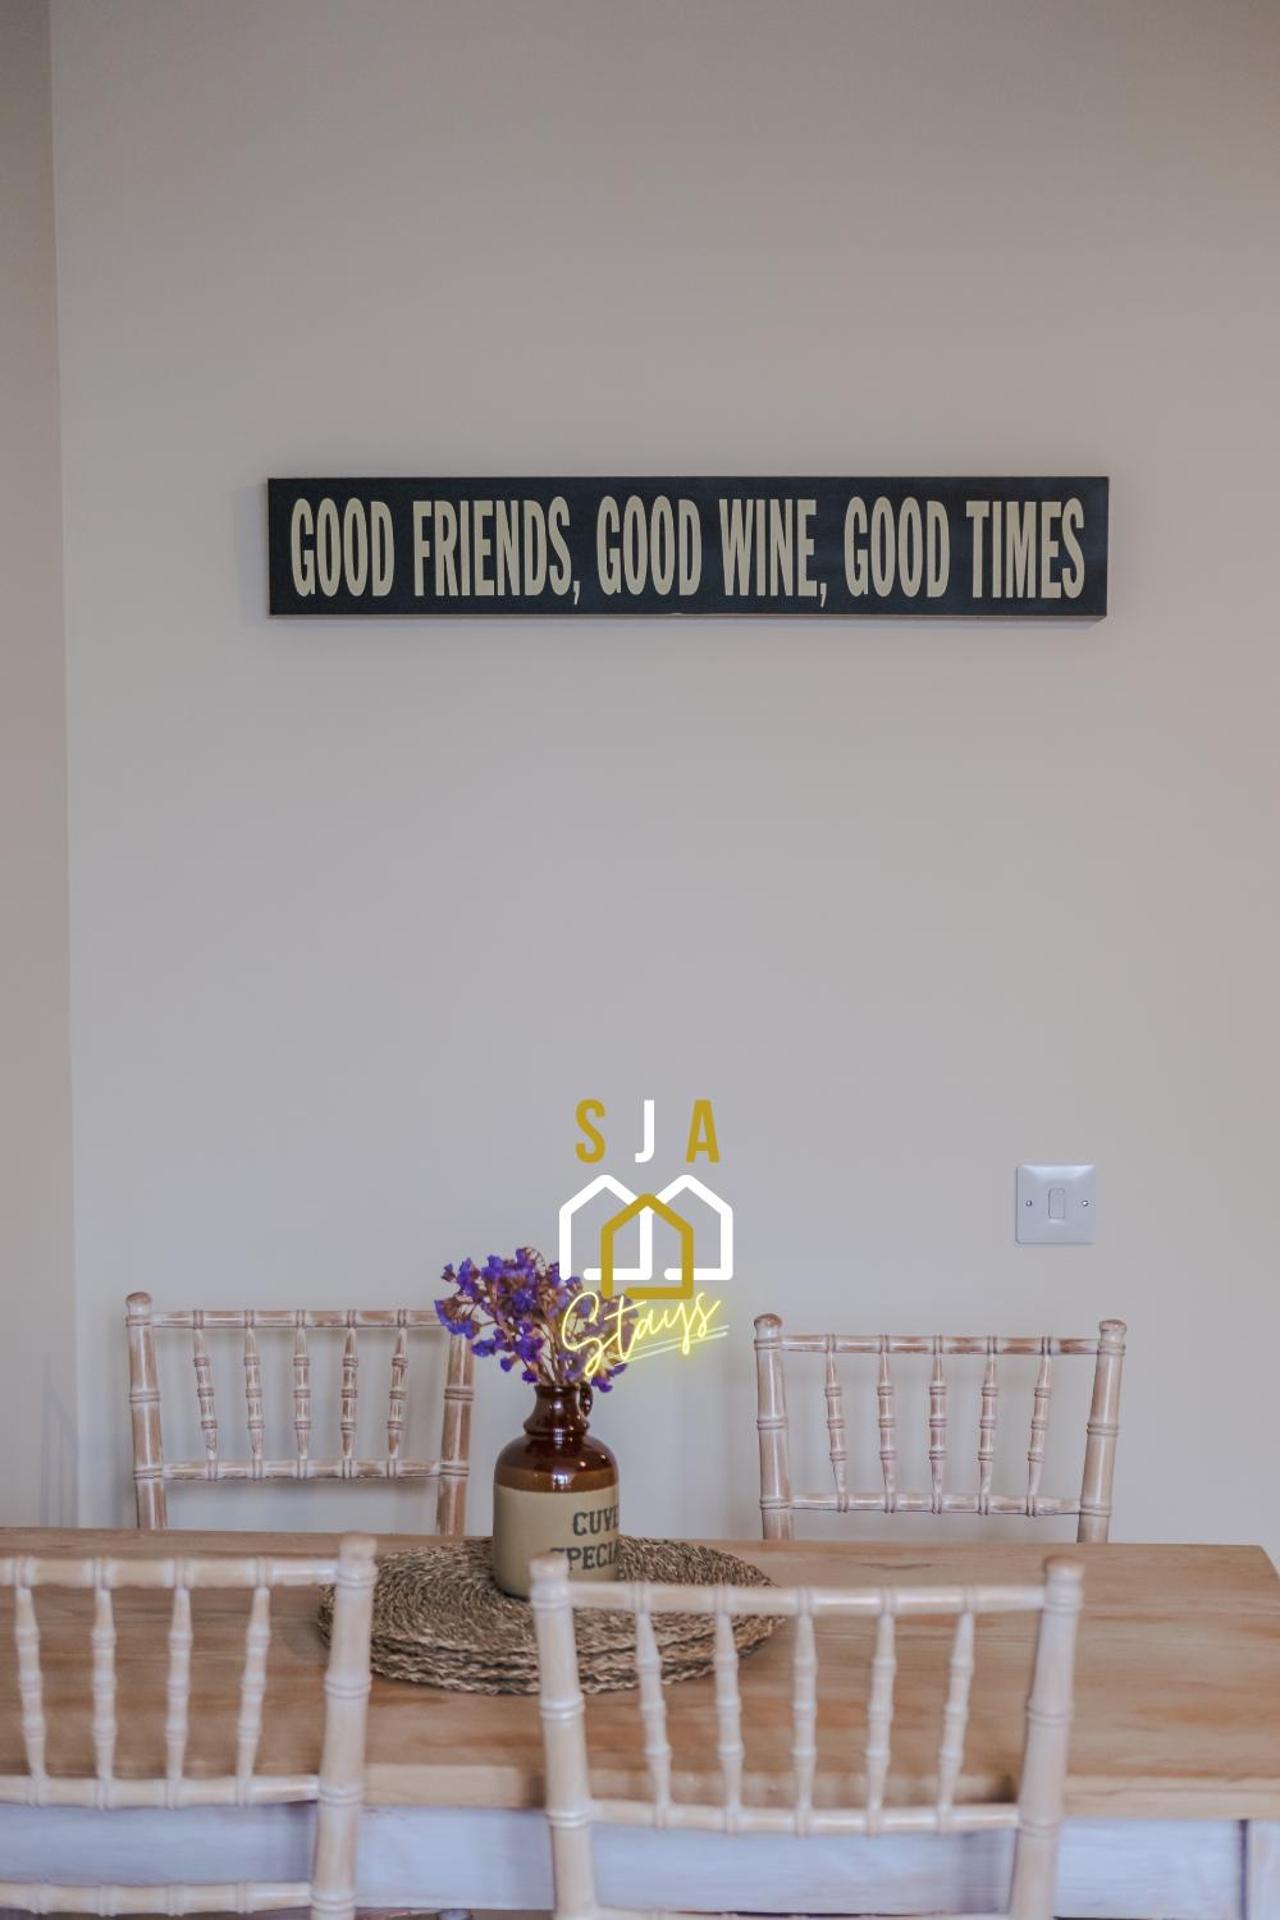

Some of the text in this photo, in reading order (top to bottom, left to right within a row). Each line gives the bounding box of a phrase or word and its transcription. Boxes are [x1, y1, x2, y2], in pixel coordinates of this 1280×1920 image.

[291, 495, 1085, 608] GOOD FRIENDS, GOOD WINE, GOOD TIMES
